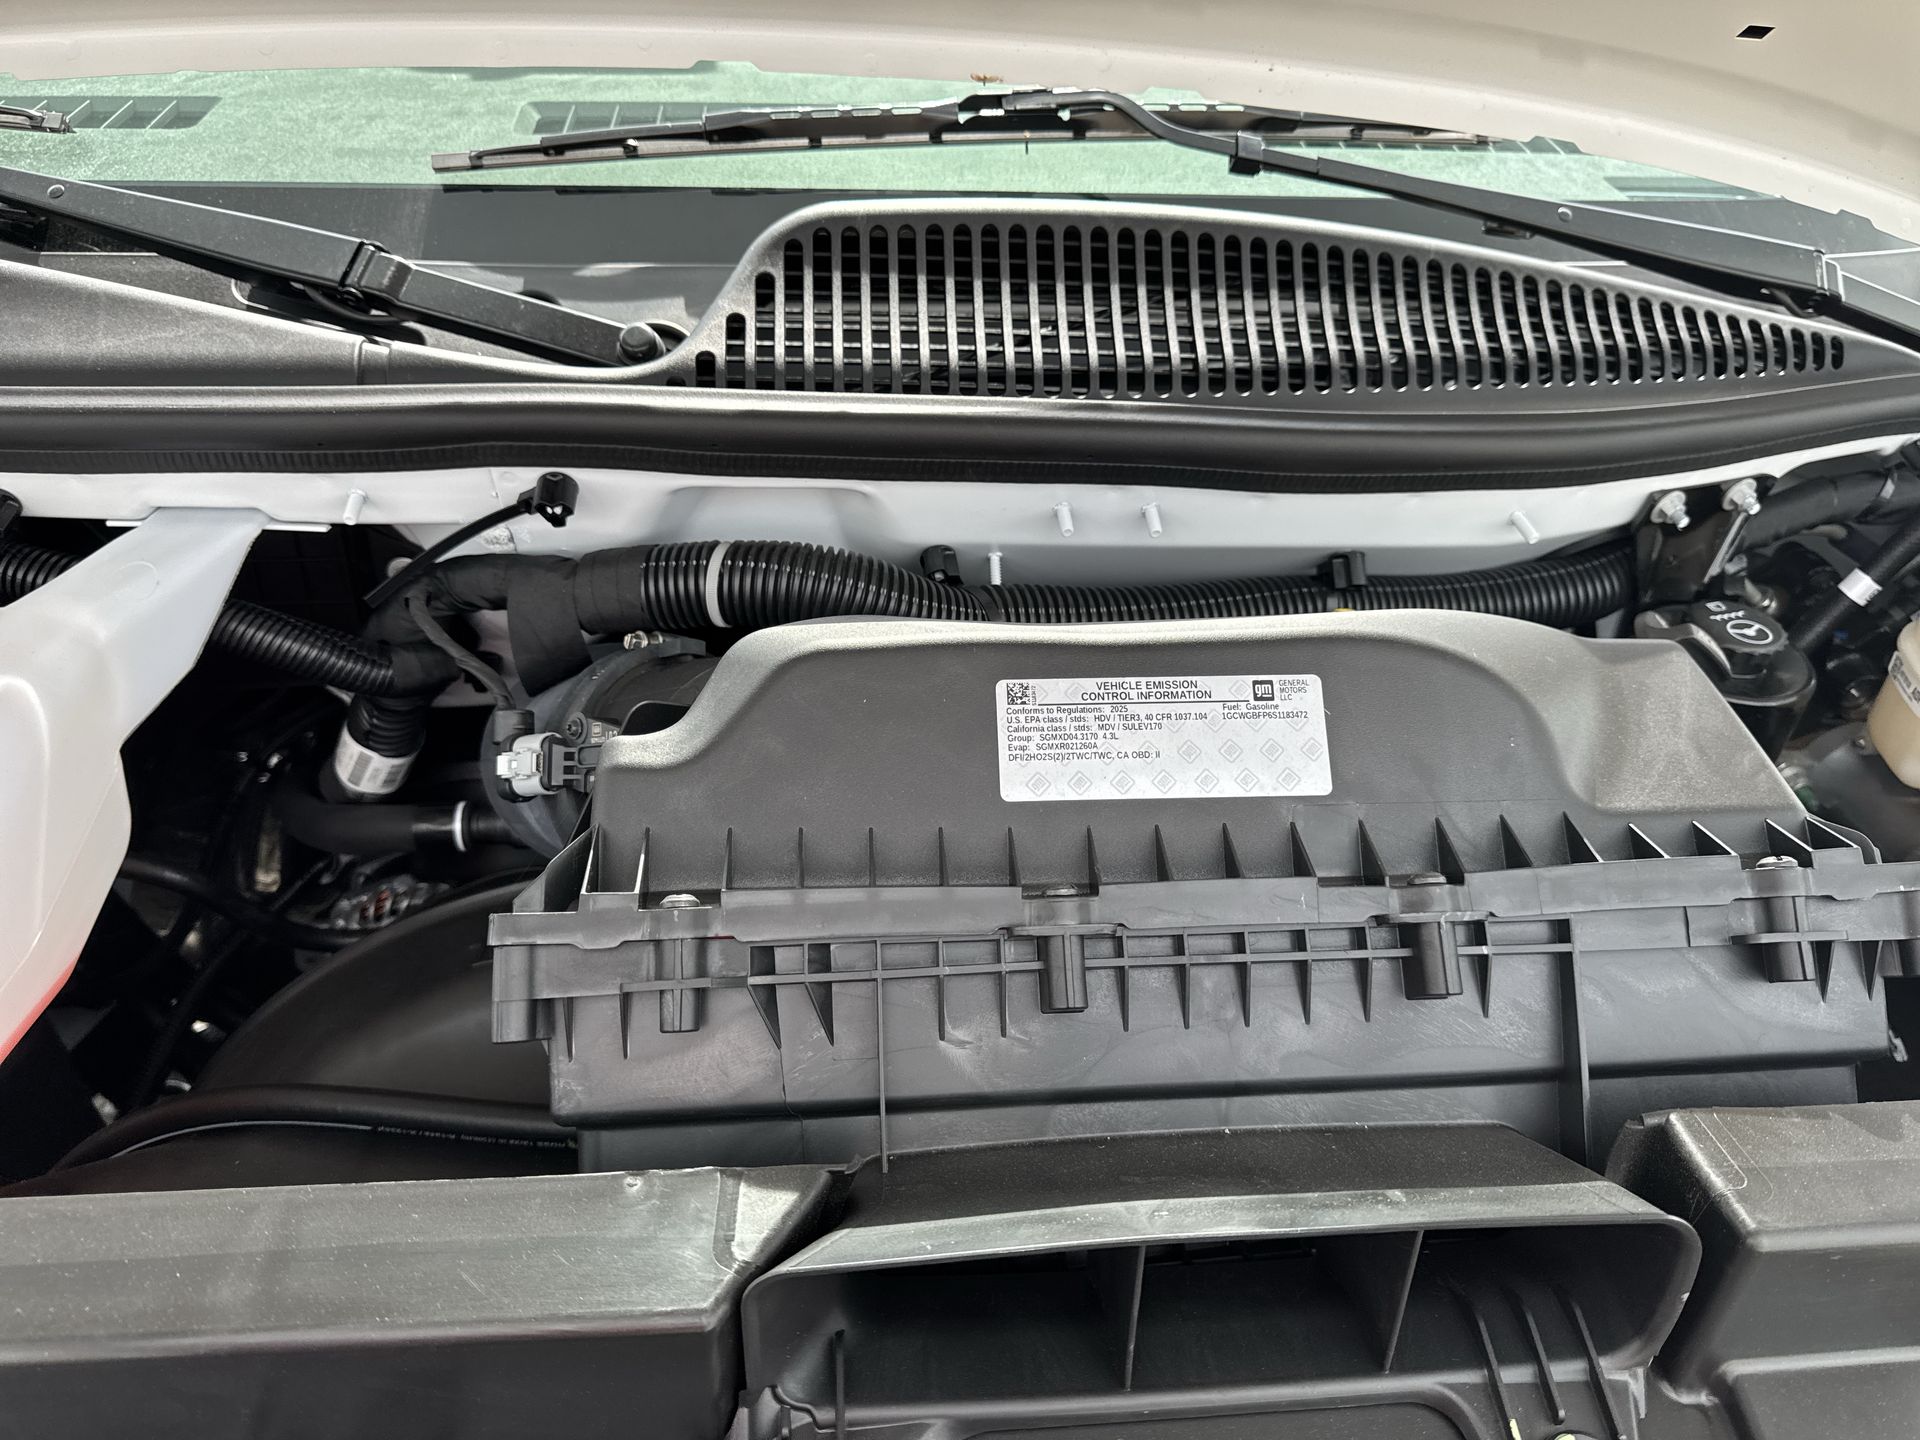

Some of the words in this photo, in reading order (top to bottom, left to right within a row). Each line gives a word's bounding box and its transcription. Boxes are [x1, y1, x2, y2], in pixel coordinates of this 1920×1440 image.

[1096, 681, 1142, 690] VEHICLE
[1145, 680, 1198, 690] EMISSION
[1279, 679, 1309, 687] GENERAL
[1081, 691, 1134, 701] CONTROL
[1137, 690, 1212, 700] INFORMATION
[1255, 684, 1272, 697] gm
[1280, 693, 1293, 701] LLC
[1006, 706, 1044, 715] Conforms
[1046, 707, 1055, 715] to
[1056, 706, 1105, 716] Regulations:
[1110, 705, 1128, 713] 2025
[1222, 703, 1242, 711] Fuel:
[1245, 702, 1280, 711] Gasoline
[1007, 716, 1022, 724] U.S.
[1024, 715, 1041, 724] EPA
[1043, 715, 1063, 723] class
[1069, 715, 1089, 723] stds:
[1094, 714, 1111, 722] HDV
[1144, 713, 1153, 721] 40
[1155, 713, 1172, 721] CFR
[1174, 712, 1208, 721] 1037.104
[1007, 725, 1045, 733] California
[1046, 724, 1067, 732] class
[1073, 723, 1092, 732] stds:
[1097, 723, 1116, 731] MDV
[1122, 722, 1162, 731] SULEV170
[1007, 734, 1035, 743] Group:
[1102, 732, 1119, 740] 4.3L
[1008, 743, 1030, 752] Evap:
[1116, 751, 1129, 759] CA
[1131, 751, 1153, 759] OBD:
